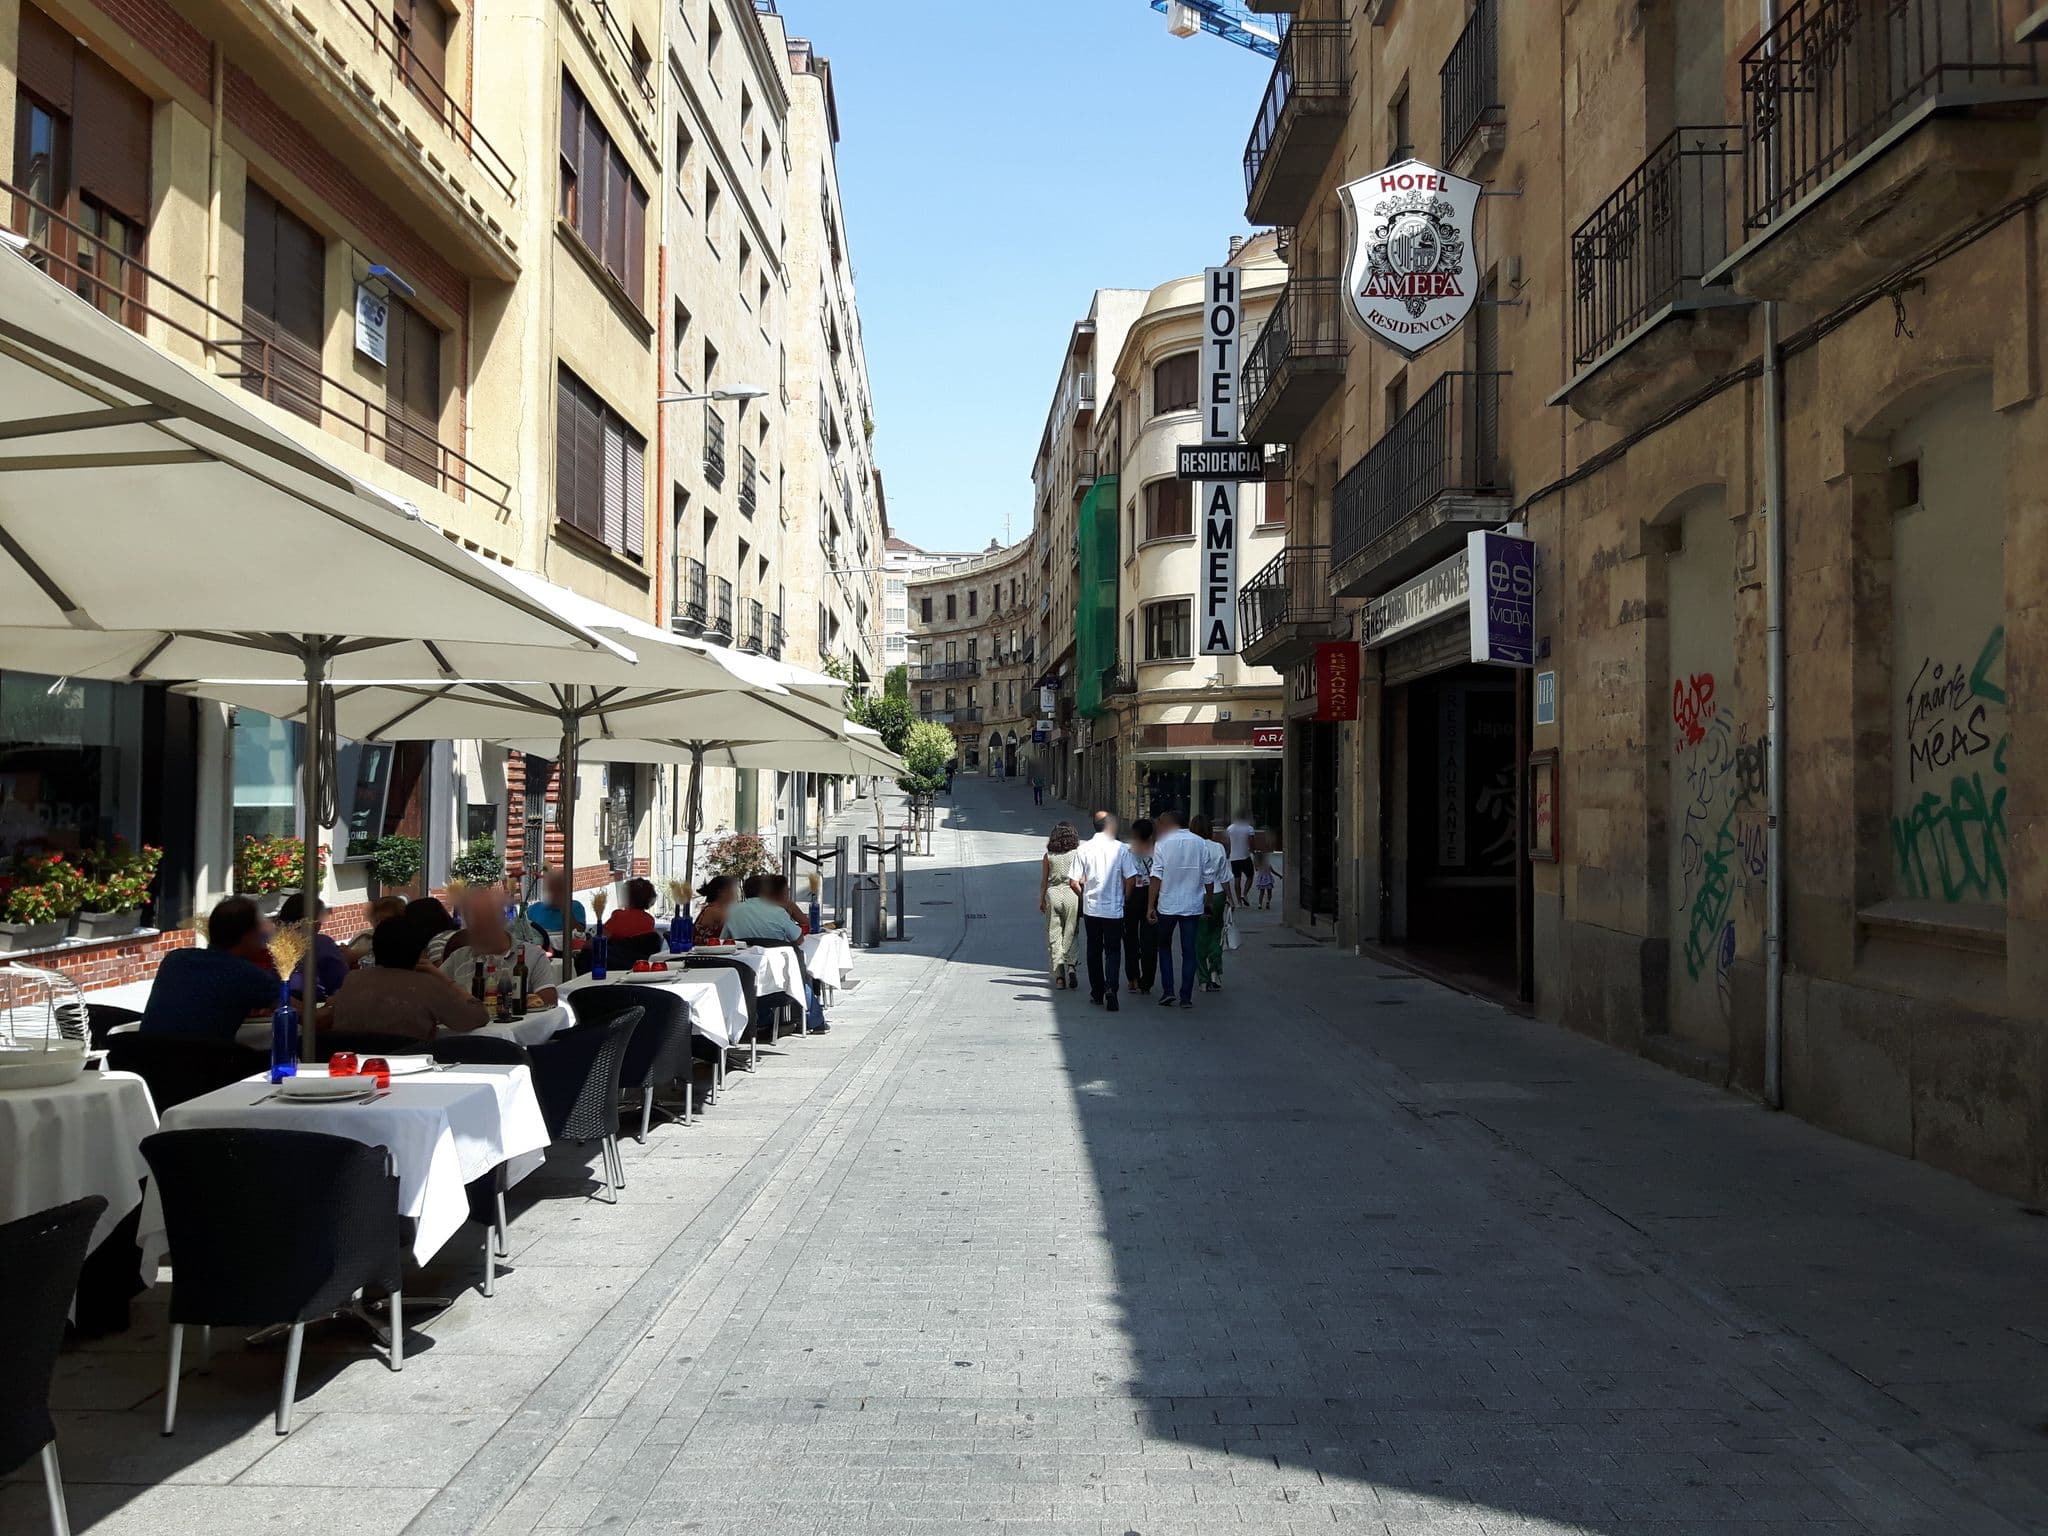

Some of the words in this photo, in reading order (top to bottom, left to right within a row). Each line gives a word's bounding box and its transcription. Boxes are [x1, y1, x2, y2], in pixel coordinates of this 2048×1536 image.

[1381, 174, 1448, 192] HOTEL
[1361, 272, 1464, 298] AMEFA
[1367, 309, 1456, 335] RESIDENCIA
[1210, 271, 1235, 439] HOTEL
[1181, 449, 1262, 473] RESIDENCIA
[1207, 484, 1235, 651] AMEFA
[1489, 560, 1532, 597] es
[1371, 589, 1424, 633] RESTAURANTE
[1426, 556, 1469, 608] JAPONÉS
[1490, 606, 1531, 628] MODA
